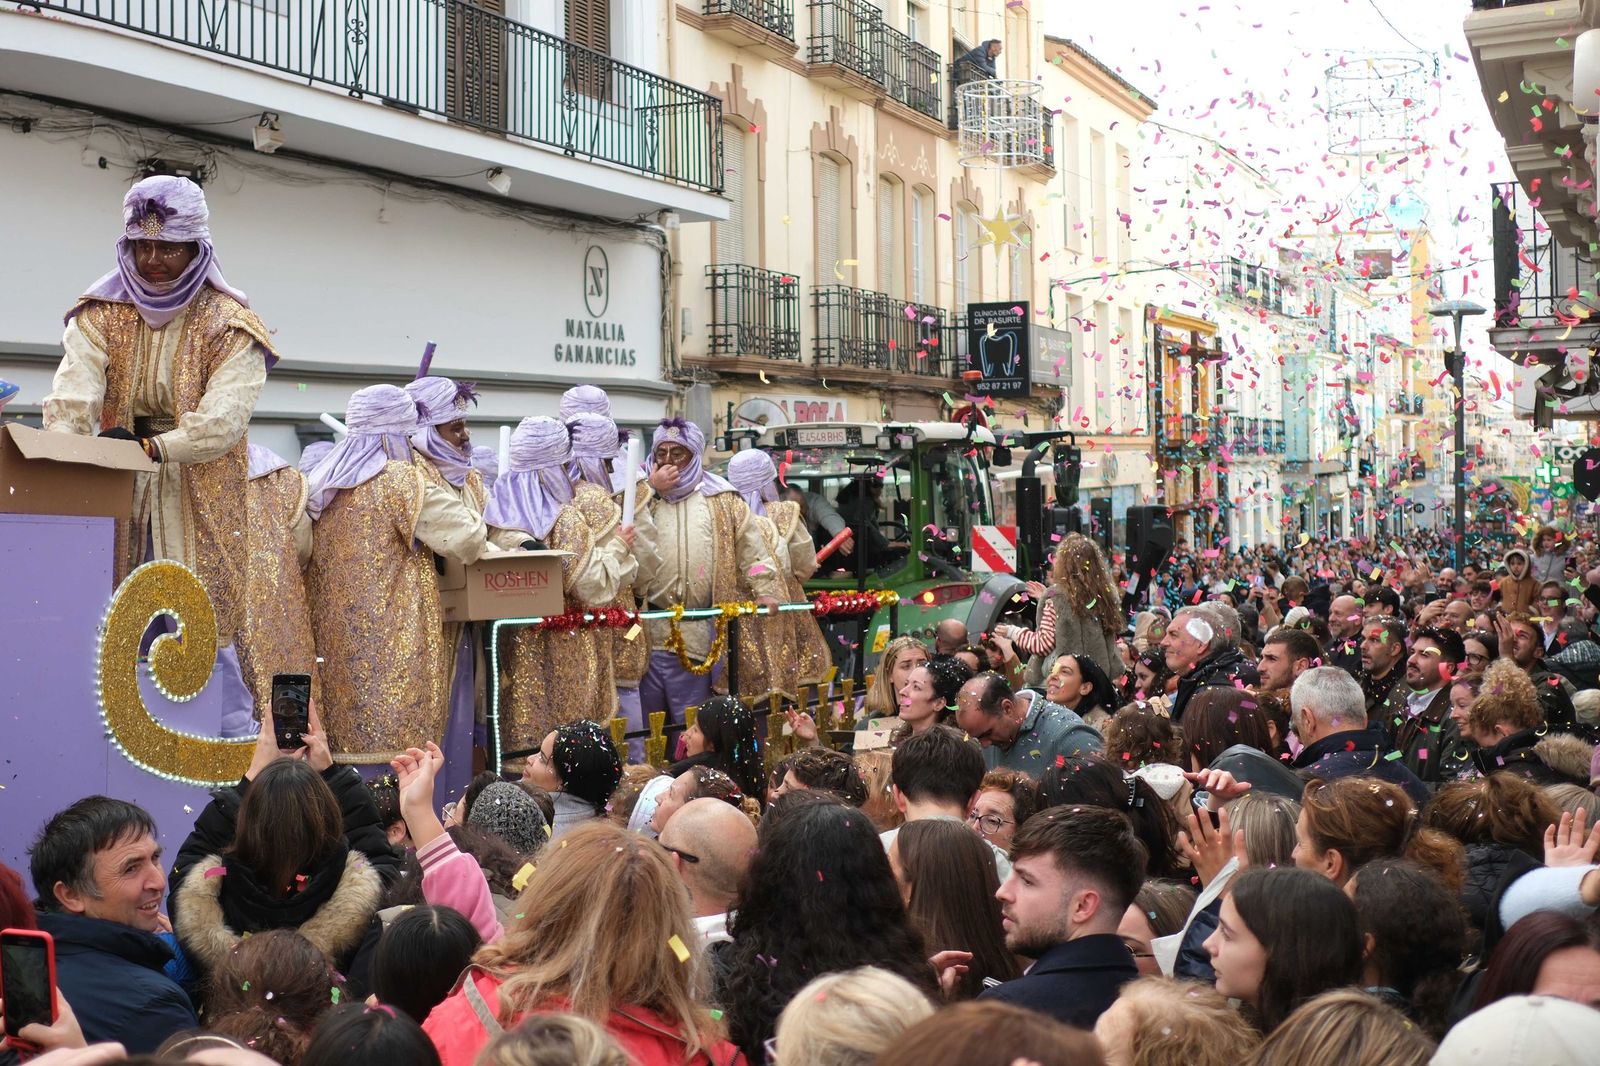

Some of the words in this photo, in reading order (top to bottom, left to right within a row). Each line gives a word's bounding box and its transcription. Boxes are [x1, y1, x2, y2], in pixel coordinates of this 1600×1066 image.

[566, 318, 626, 342] NATALIA
[554, 343, 637, 367] GANANCIAS
[977, 382, 989, 390] 952
[1012, 381, 1022, 389] 97
[484, 570, 549, 590] ROSHEN
